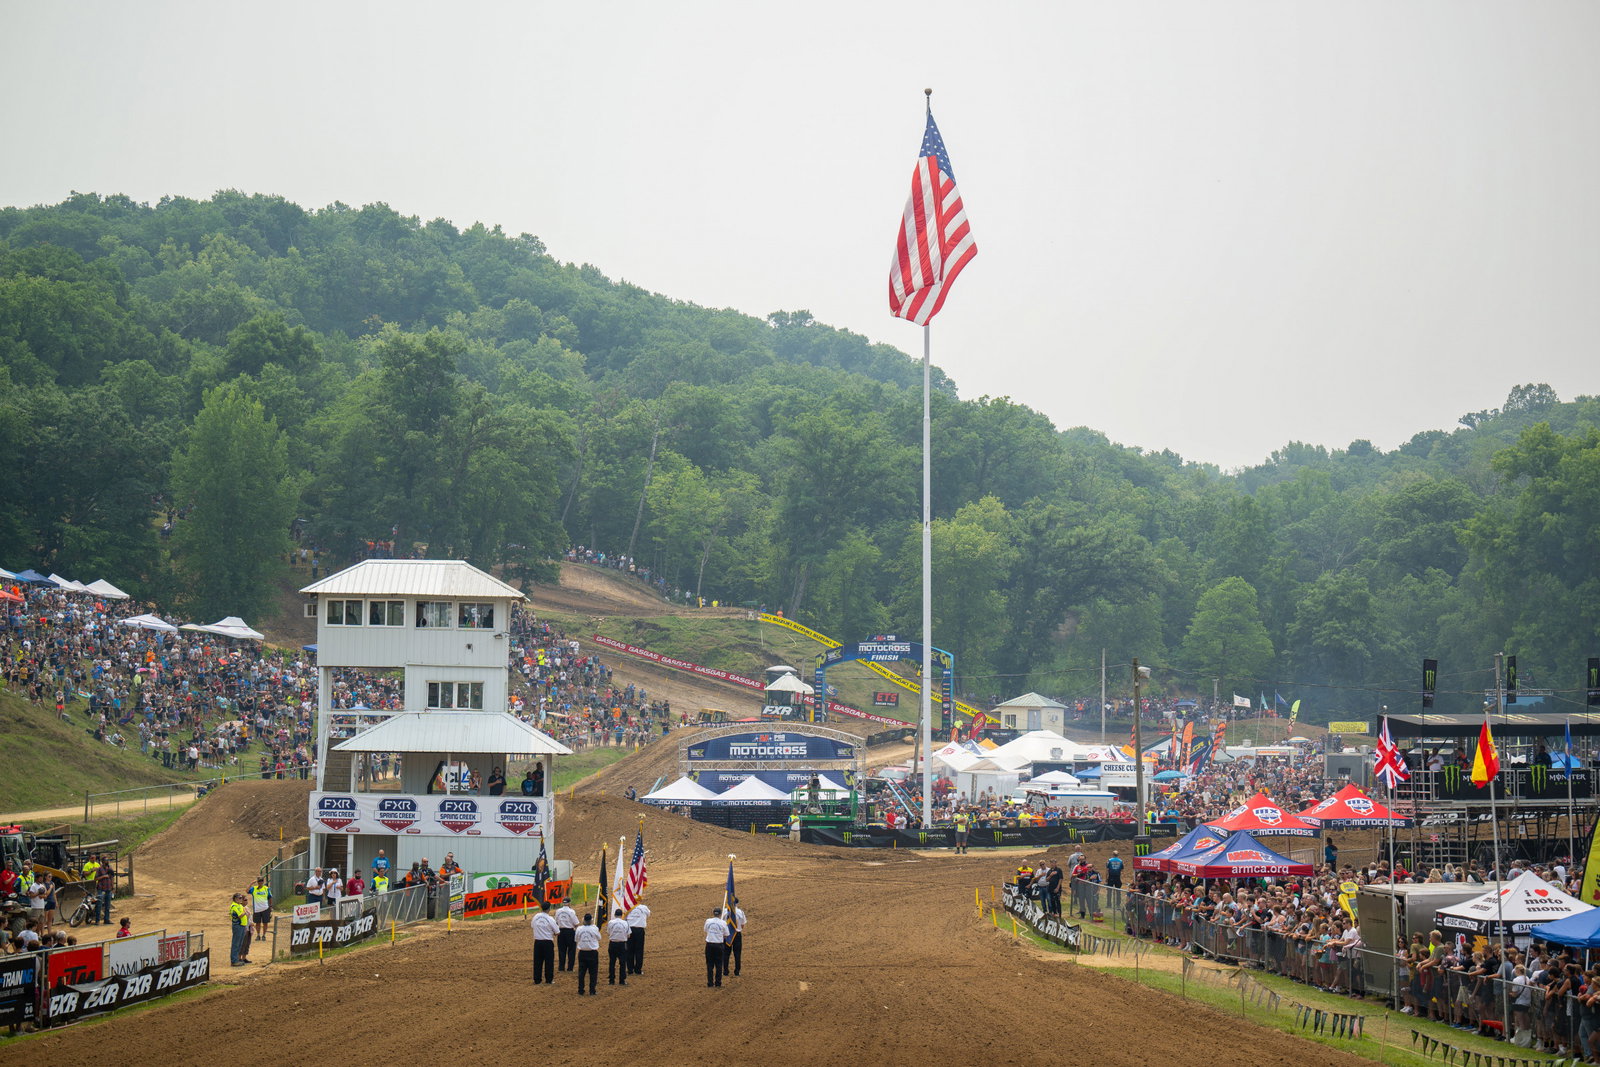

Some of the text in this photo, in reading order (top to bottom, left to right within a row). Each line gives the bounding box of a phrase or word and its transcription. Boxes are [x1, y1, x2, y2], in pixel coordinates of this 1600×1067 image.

[596, 636, 761, 688] GASGAS GASGAS GASGAS GASGAS GASGAS
[876, 692, 898, 702] ETS
[762, 706, 792, 715] FXR
[834, 704, 867, 719] GASGAS
[730, 746, 807, 755] MOTOCROSS
[1103, 764, 1123, 772] CHEESE
[1549, 773, 1586, 781] MONTER
[324, 799, 350, 809] FXR
[384, 800, 411, 810] FXR
[445, 801, 472, 812] FXR
[505, 803, 532, 813] FXR
[319, 810, 337, 818] SPRING
[1141, 859, 1161, 870] armca.org
[1177, 862, 1197, 875] armca.org
[1231, 865, 1289, 874] armca.org
[464, 895, 488, 912] KTM
[492, 891, 517, 908] KTM
[292, 914, 374, 945] FXR FXR FXR FXR
[50, 991, 79, 1018] FXR
[83, 983, 119, 1009] FXR
[122, 973, 152, 1000] FXR
[156, 965, 184, 990] FXR
[186, 956, 208, 980] FXR
